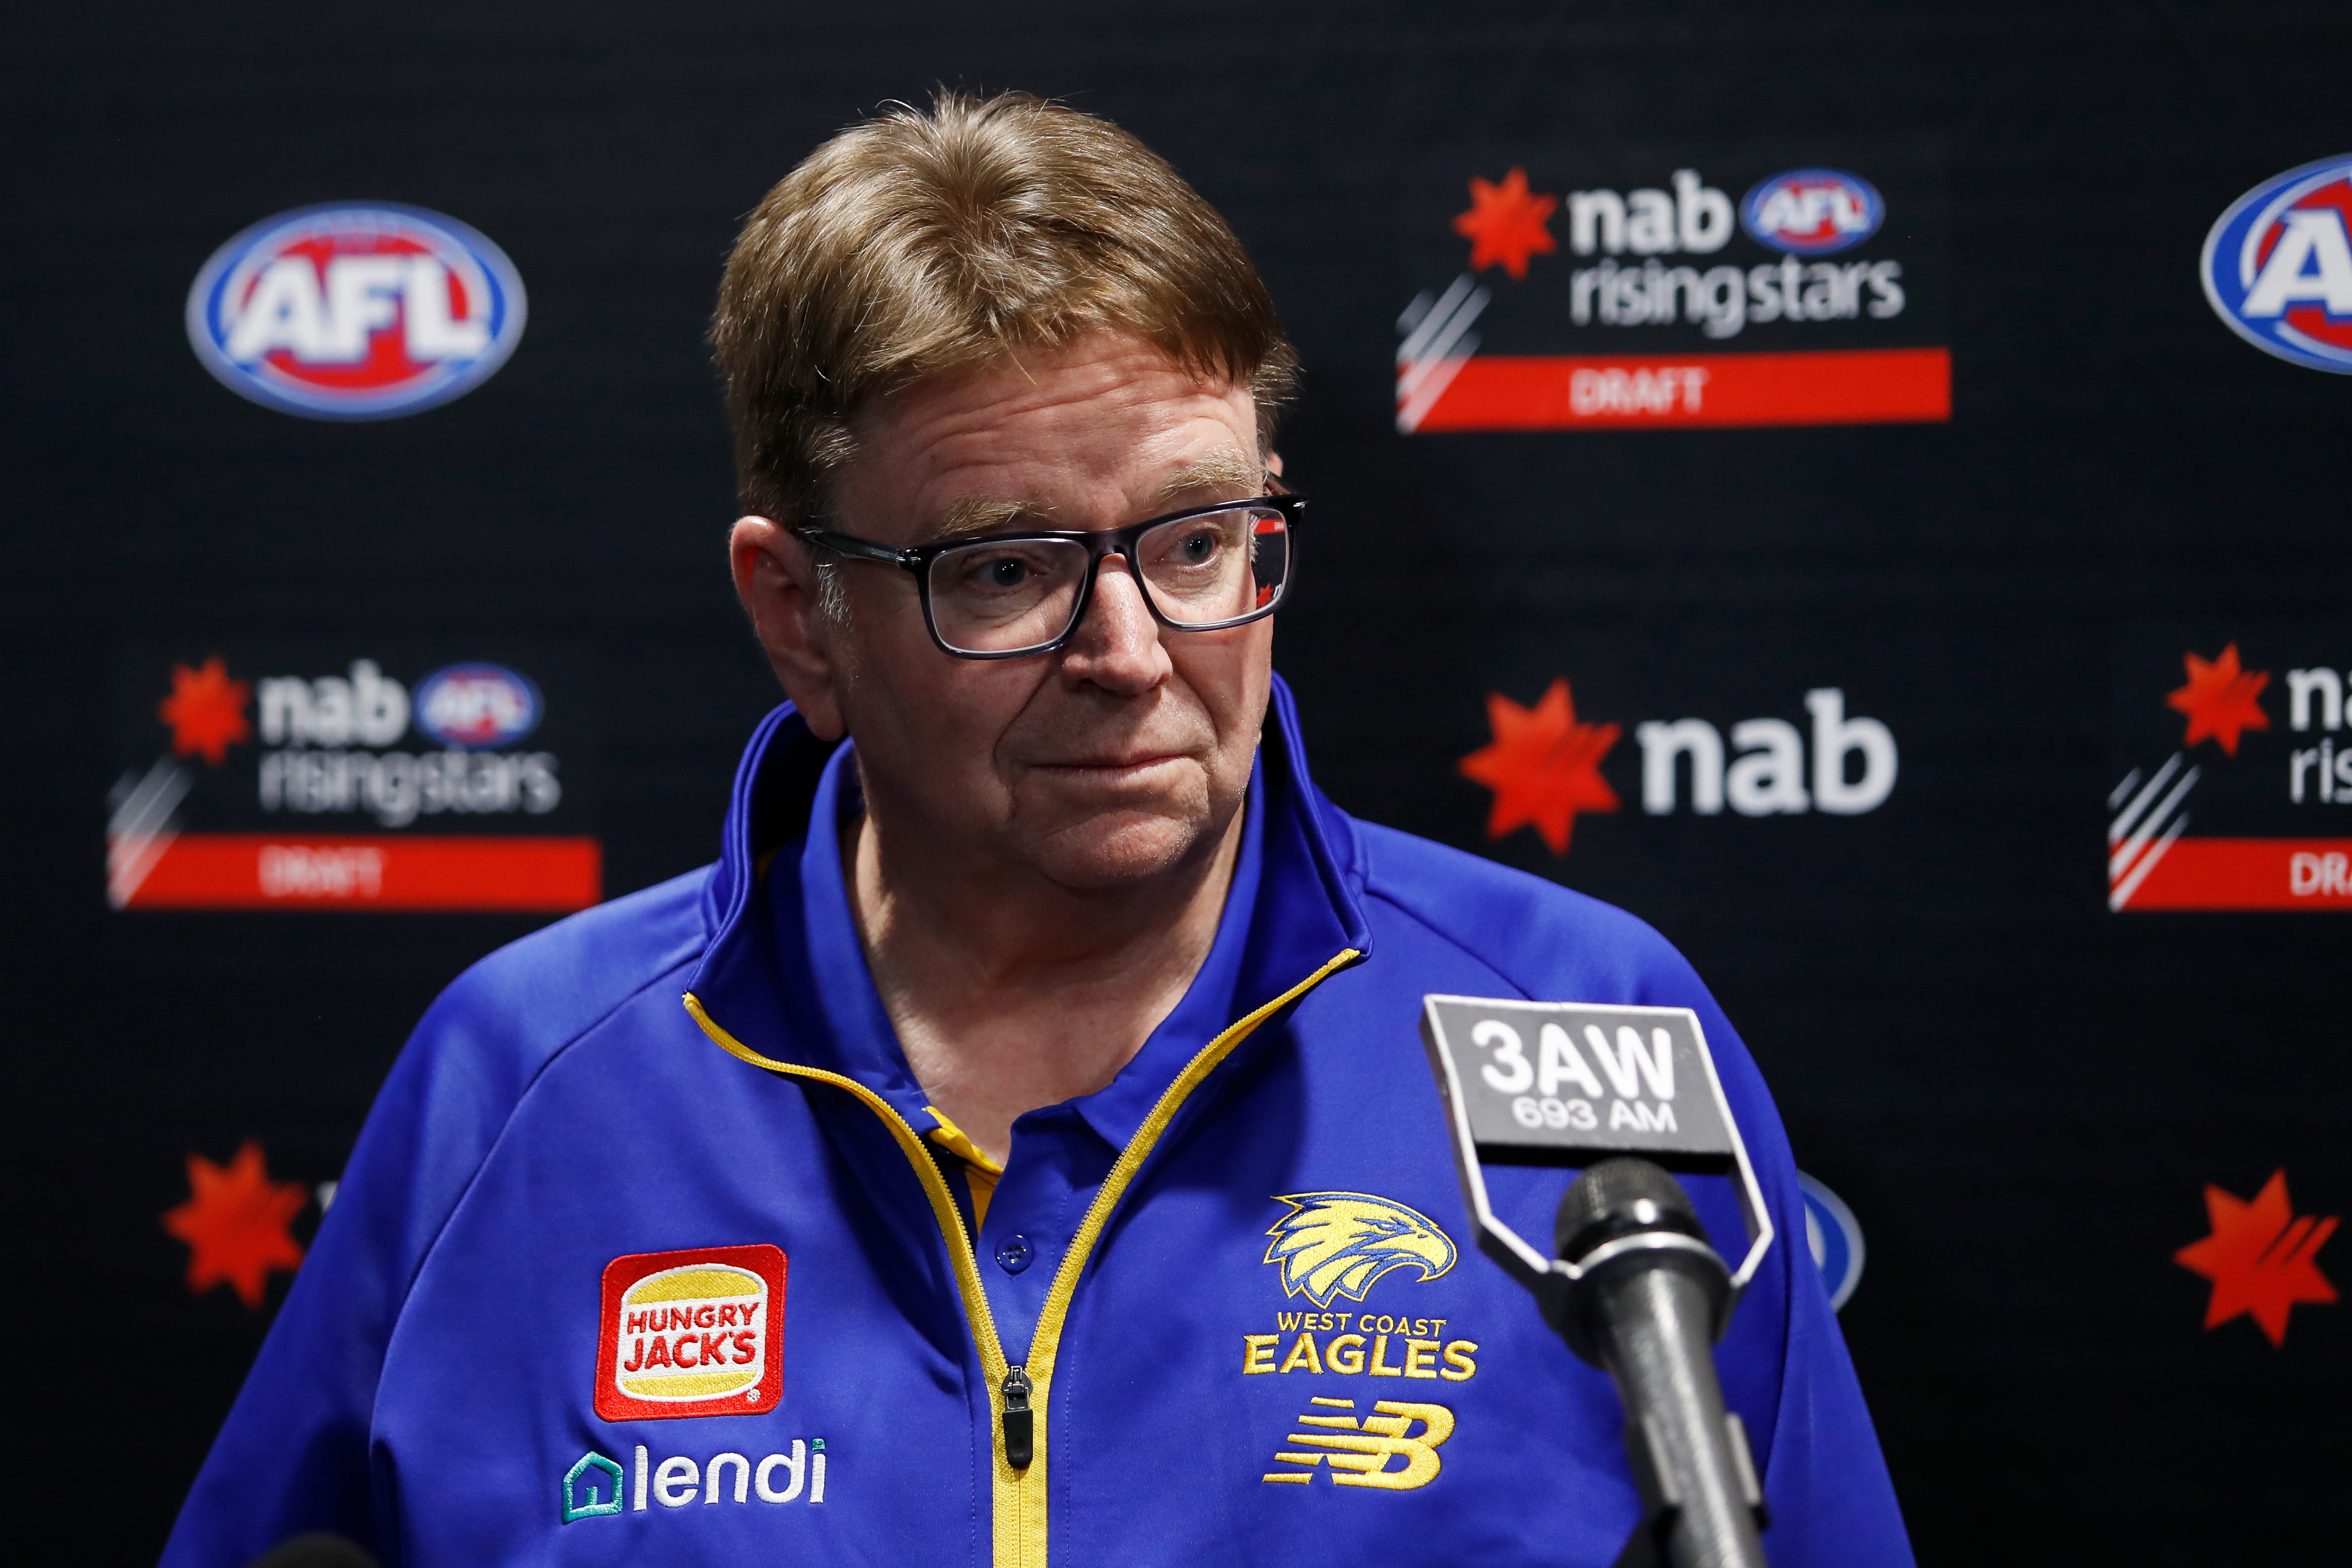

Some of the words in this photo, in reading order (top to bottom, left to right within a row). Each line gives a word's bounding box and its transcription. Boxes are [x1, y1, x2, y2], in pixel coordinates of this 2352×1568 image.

[1568, 169, 1733, 255] nab
[1758, 189, 1867, 234] AFL
[225, 252, 490, 363] AFL
[1569, 366, 1707, 415] DRAFT
[259, 660, 410, 746] nab
[1637, 688, 1898, 816] nab
[1472, 1020, 1675, 1099] 3AW
[1512, 1096, 1598, 1130] 693
[1609, 1100, 1678, 1132] AM
[627, 1302, 760, 1335] HUNGRY
[1277, 1311, 1352, 1332] WEST
[1359, 1314, 1447, 1337] COAST
[624, 1330, 756, 1372] JACK'S
[1243, 1332, 1479, 1381] EAGLES
[633, 1438, 826, 1511] lendi
